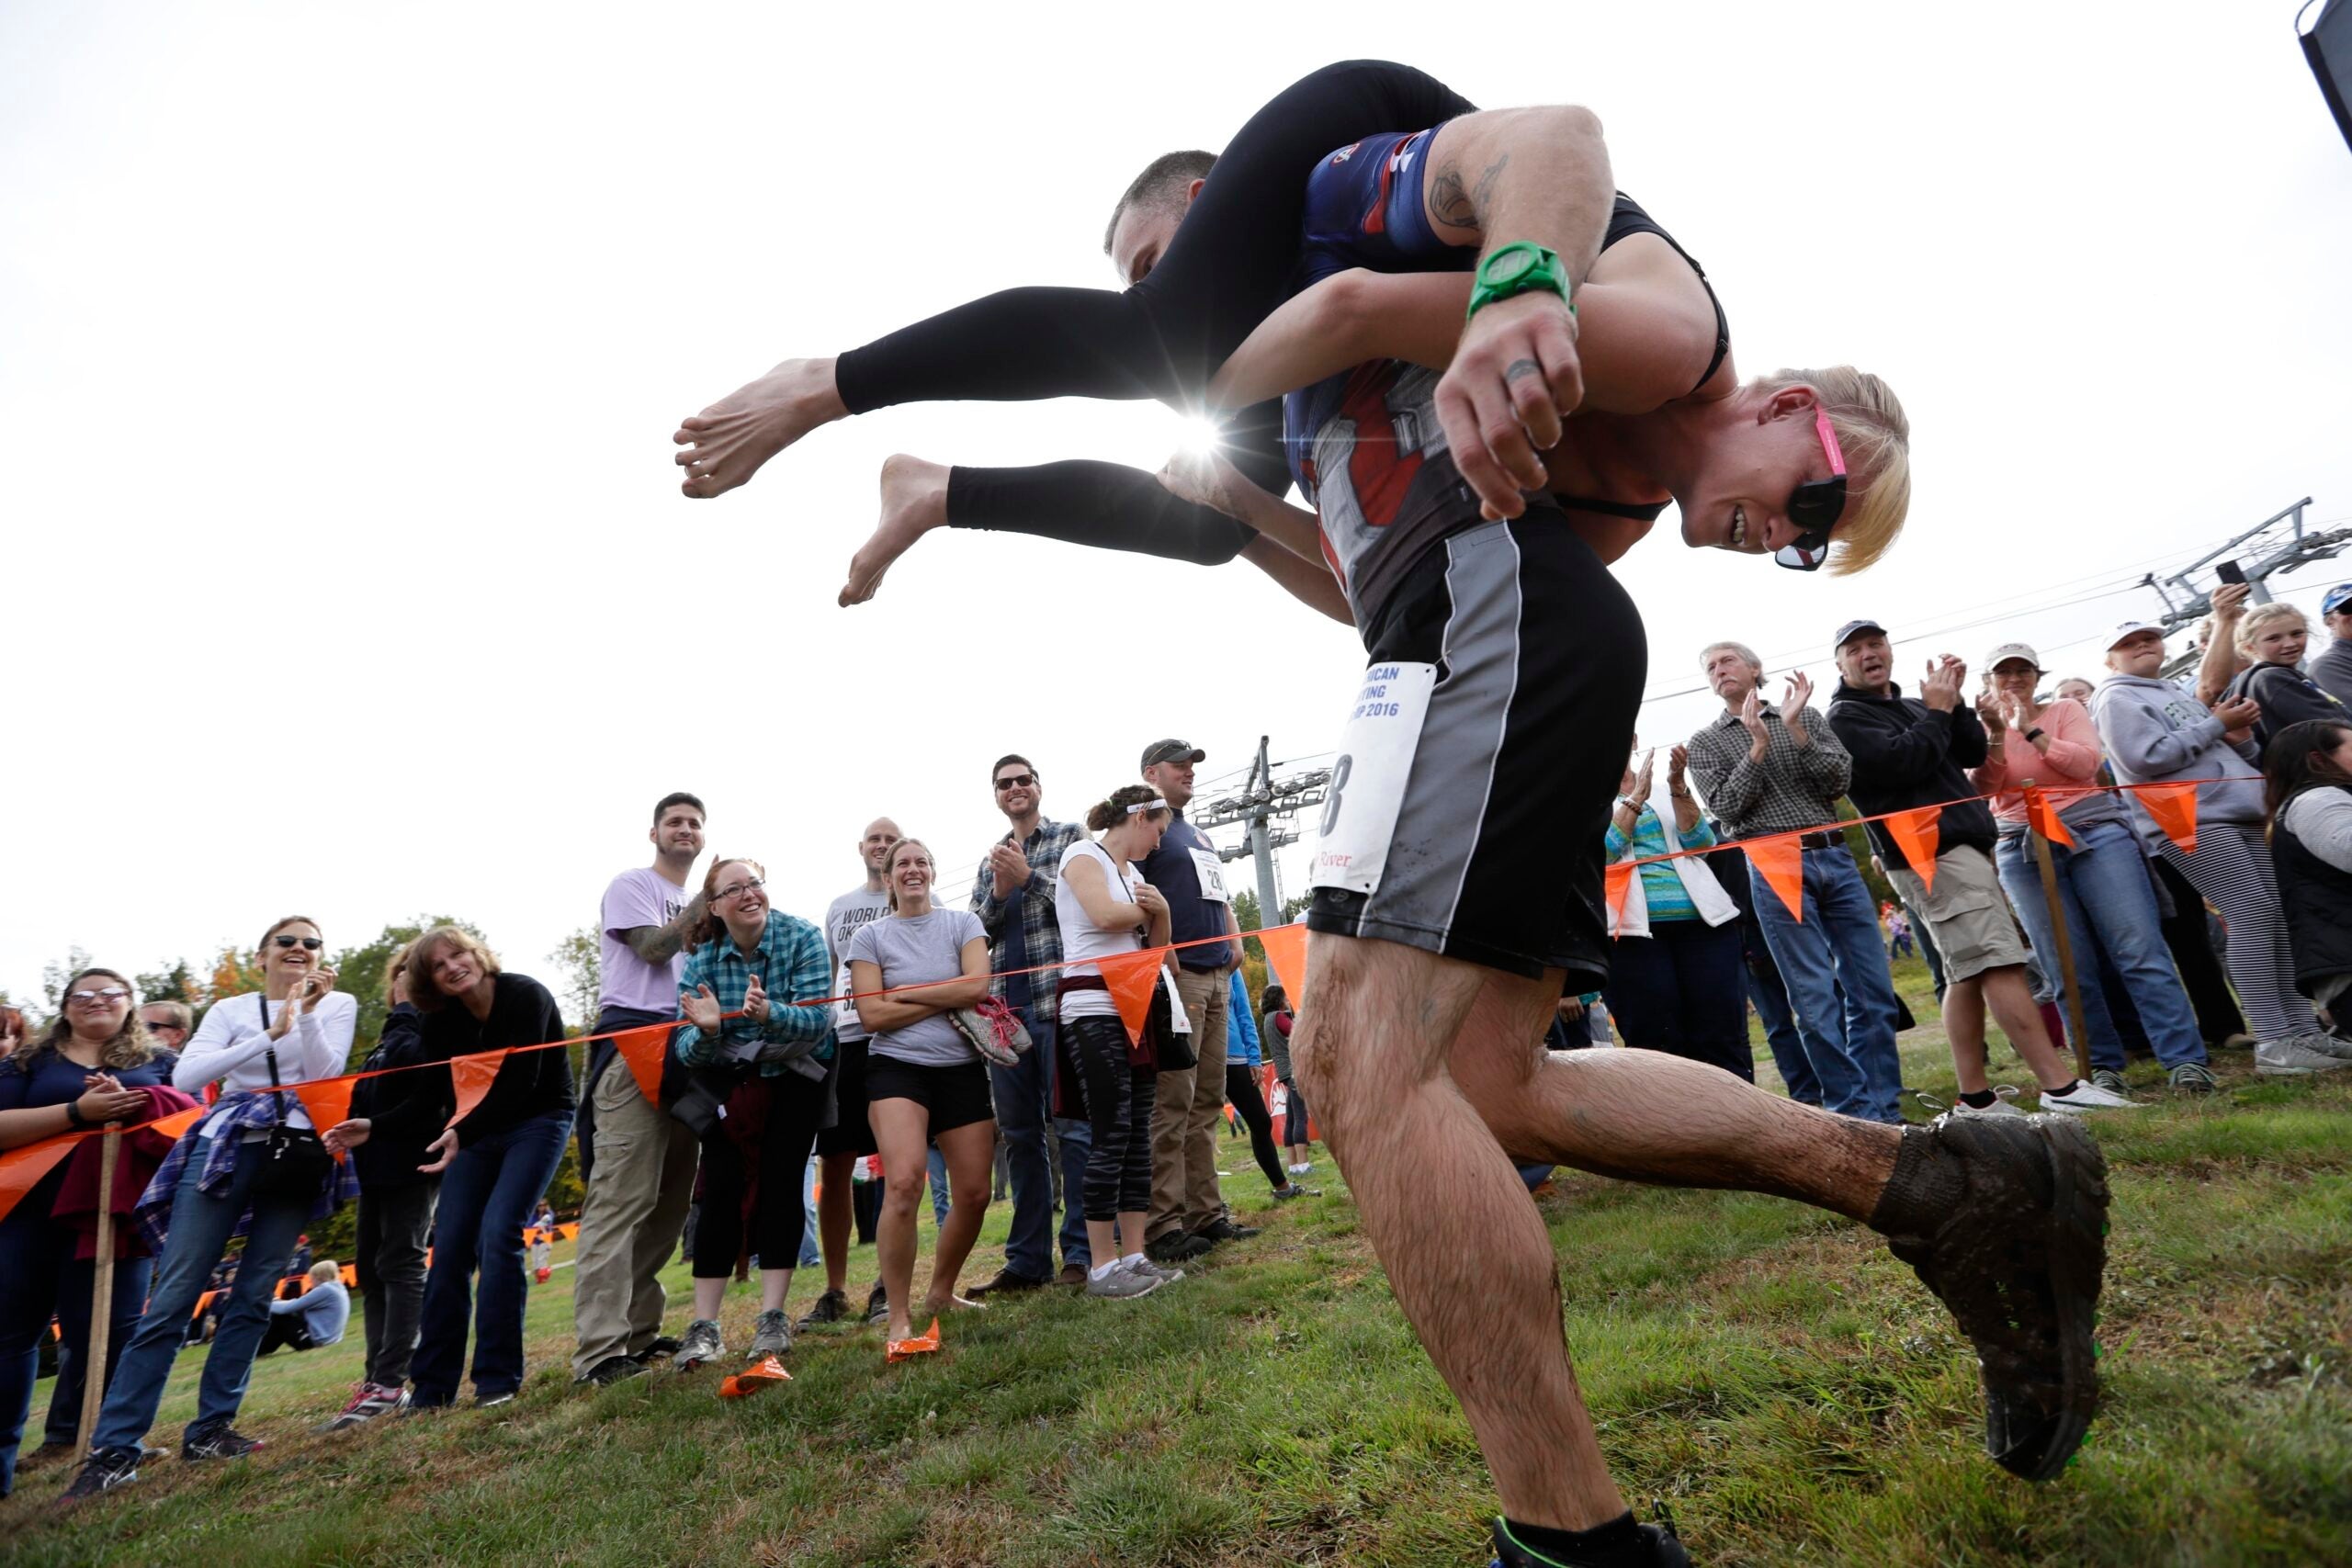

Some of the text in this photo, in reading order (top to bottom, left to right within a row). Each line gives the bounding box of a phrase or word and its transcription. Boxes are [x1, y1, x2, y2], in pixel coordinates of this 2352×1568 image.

[1366, 702, 1399, 716] 2016
[1319, 754, 1352, 838] 8
[1321, 851, 1352, 867] River
[1206, 869, 1223, 891] 28
[842, 906, 890, 924] WORLD
[837, 924, 862, 942] OK
